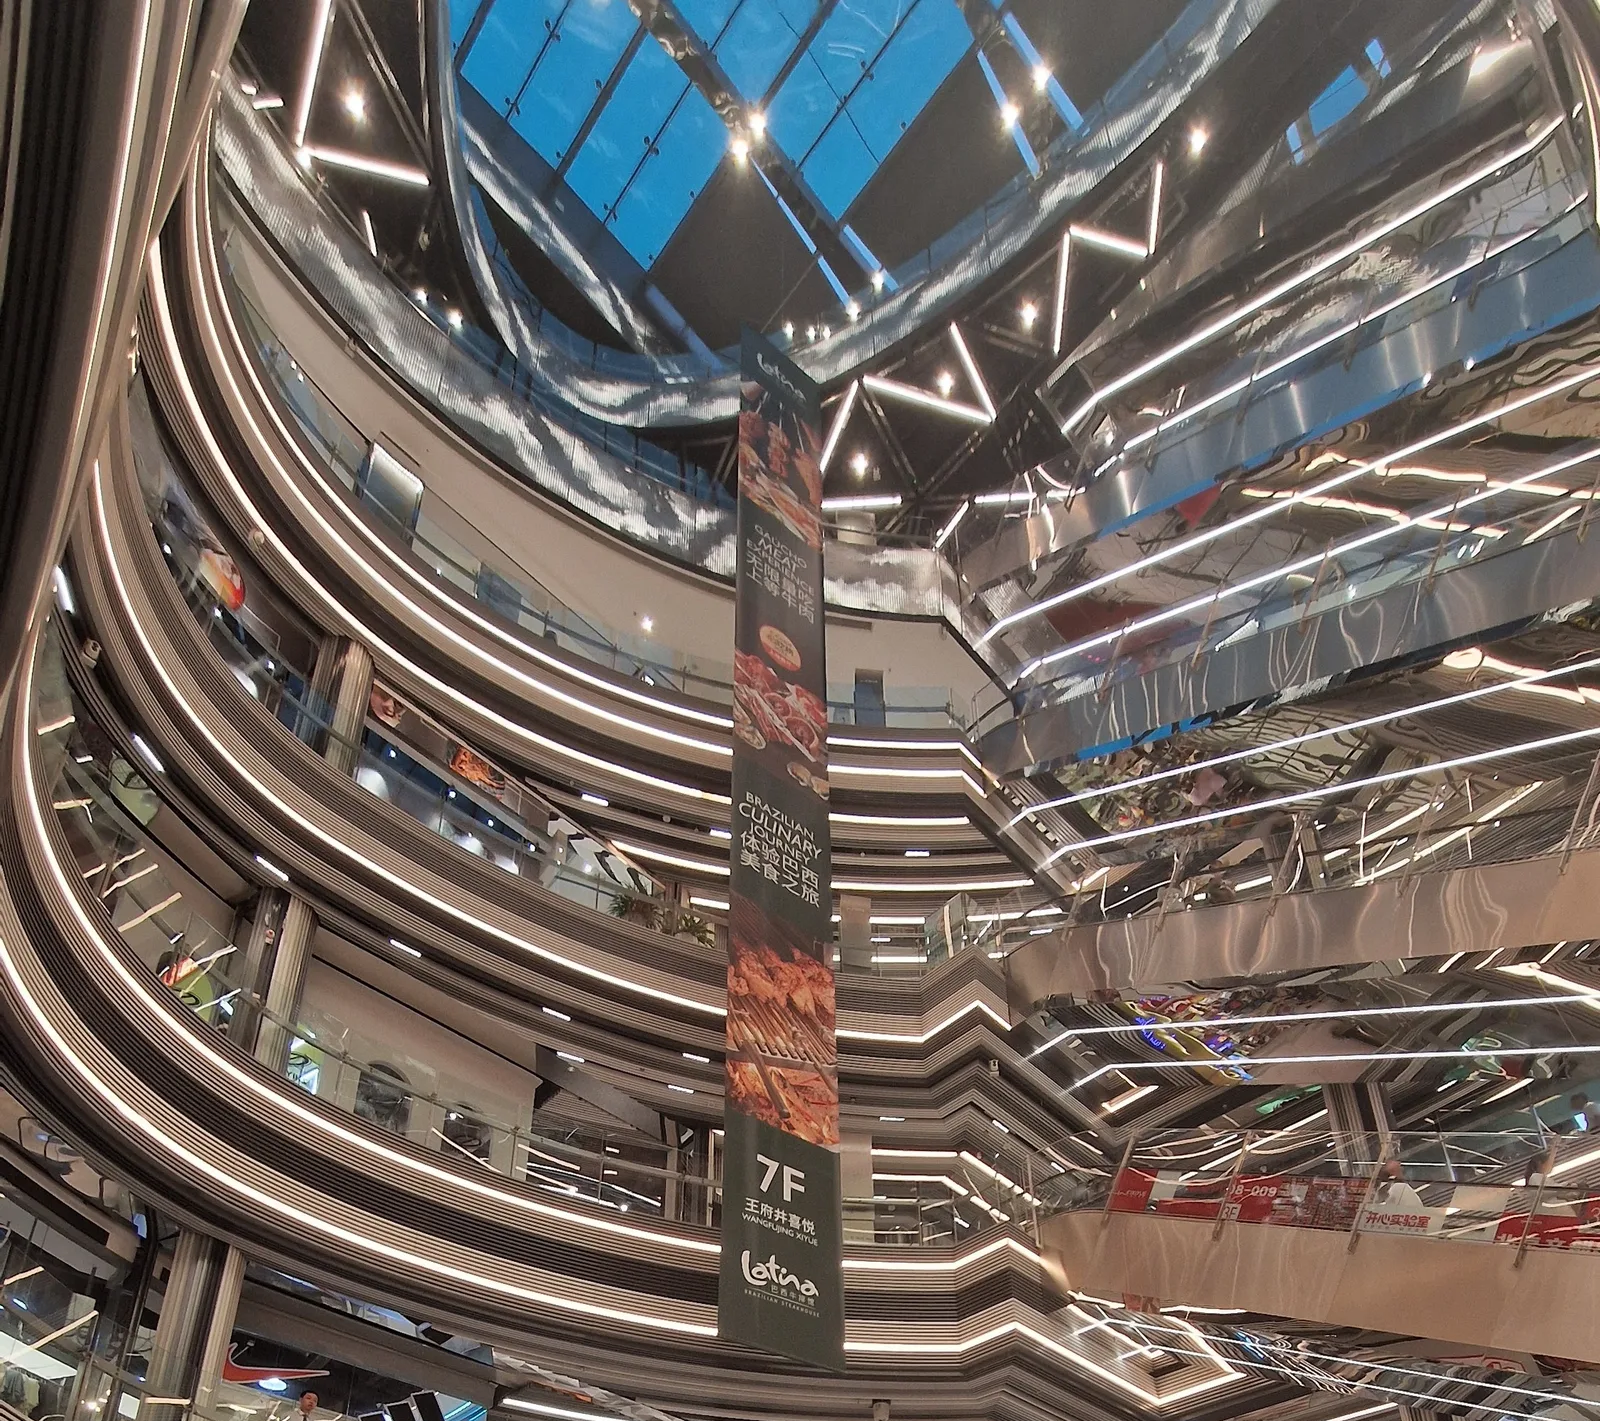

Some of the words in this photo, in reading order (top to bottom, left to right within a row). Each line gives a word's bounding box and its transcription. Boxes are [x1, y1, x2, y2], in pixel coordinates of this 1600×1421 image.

[746, 538, 815, 597] EXPERIENCE
[754, 524, 808, 569] GAUCHO
[758, 539, 800, 573] MEAT
[745, 566, 815, 625] 上等牛肉
[746, 551, 815, 611] 无限量吃
[738, 802, 823, 859] CULINARY
[746, 791, 815, 842] BRAZILIAN
[740, 830, 819, 890] 体验巴西
[749, 822, 811, 865] JOURNEY
[740, 848, 820, 909] 美食之旅
[756, 1153, 805, 1202] 7F
[742, 1212, 795, 1238] WANGFUJING
[796, 1232, 819, 1247] XIYUE
[744, 1197, 816, 1236] 王府井喜悦
[1365, 1213, 1431, 1229] 开心实验室
[741, 1250, 820, 1297] Latina
[744, 1288, 779, 1304] BRAZILIAN
[781, 1300, 821, 1318] STEAKHOUSE
